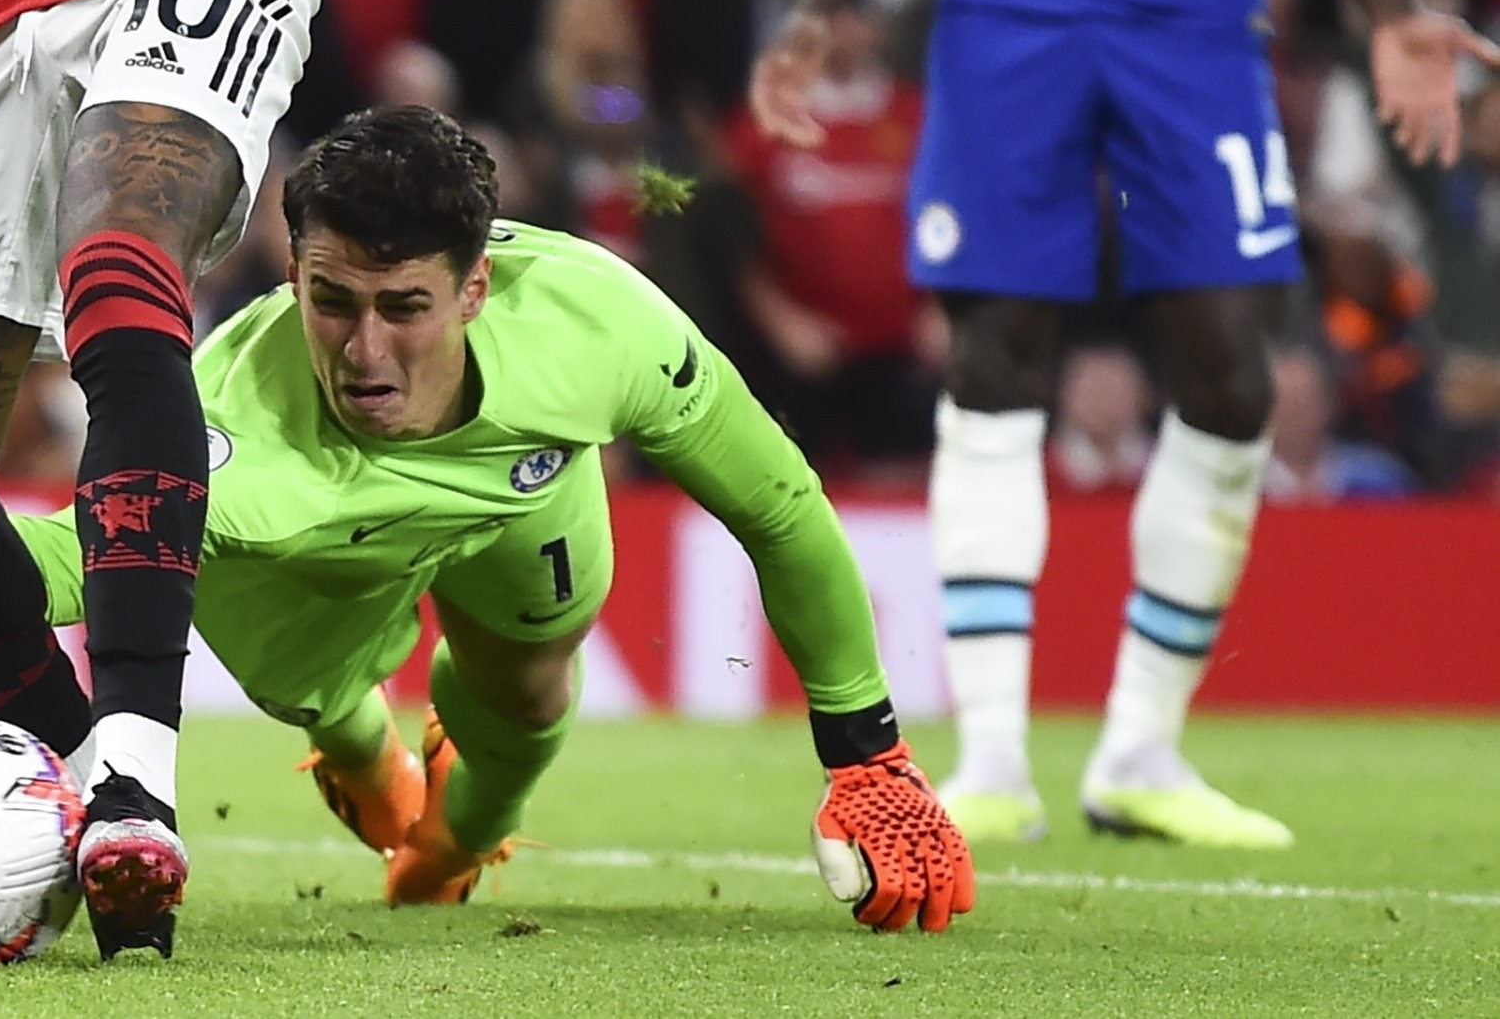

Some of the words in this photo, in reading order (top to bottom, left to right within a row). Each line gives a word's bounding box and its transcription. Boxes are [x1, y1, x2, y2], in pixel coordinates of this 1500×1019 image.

[125, 57, 185, 75] adidas
[1214, 130, 1297, 225] 14
[540, 535, 573, 603] 1
